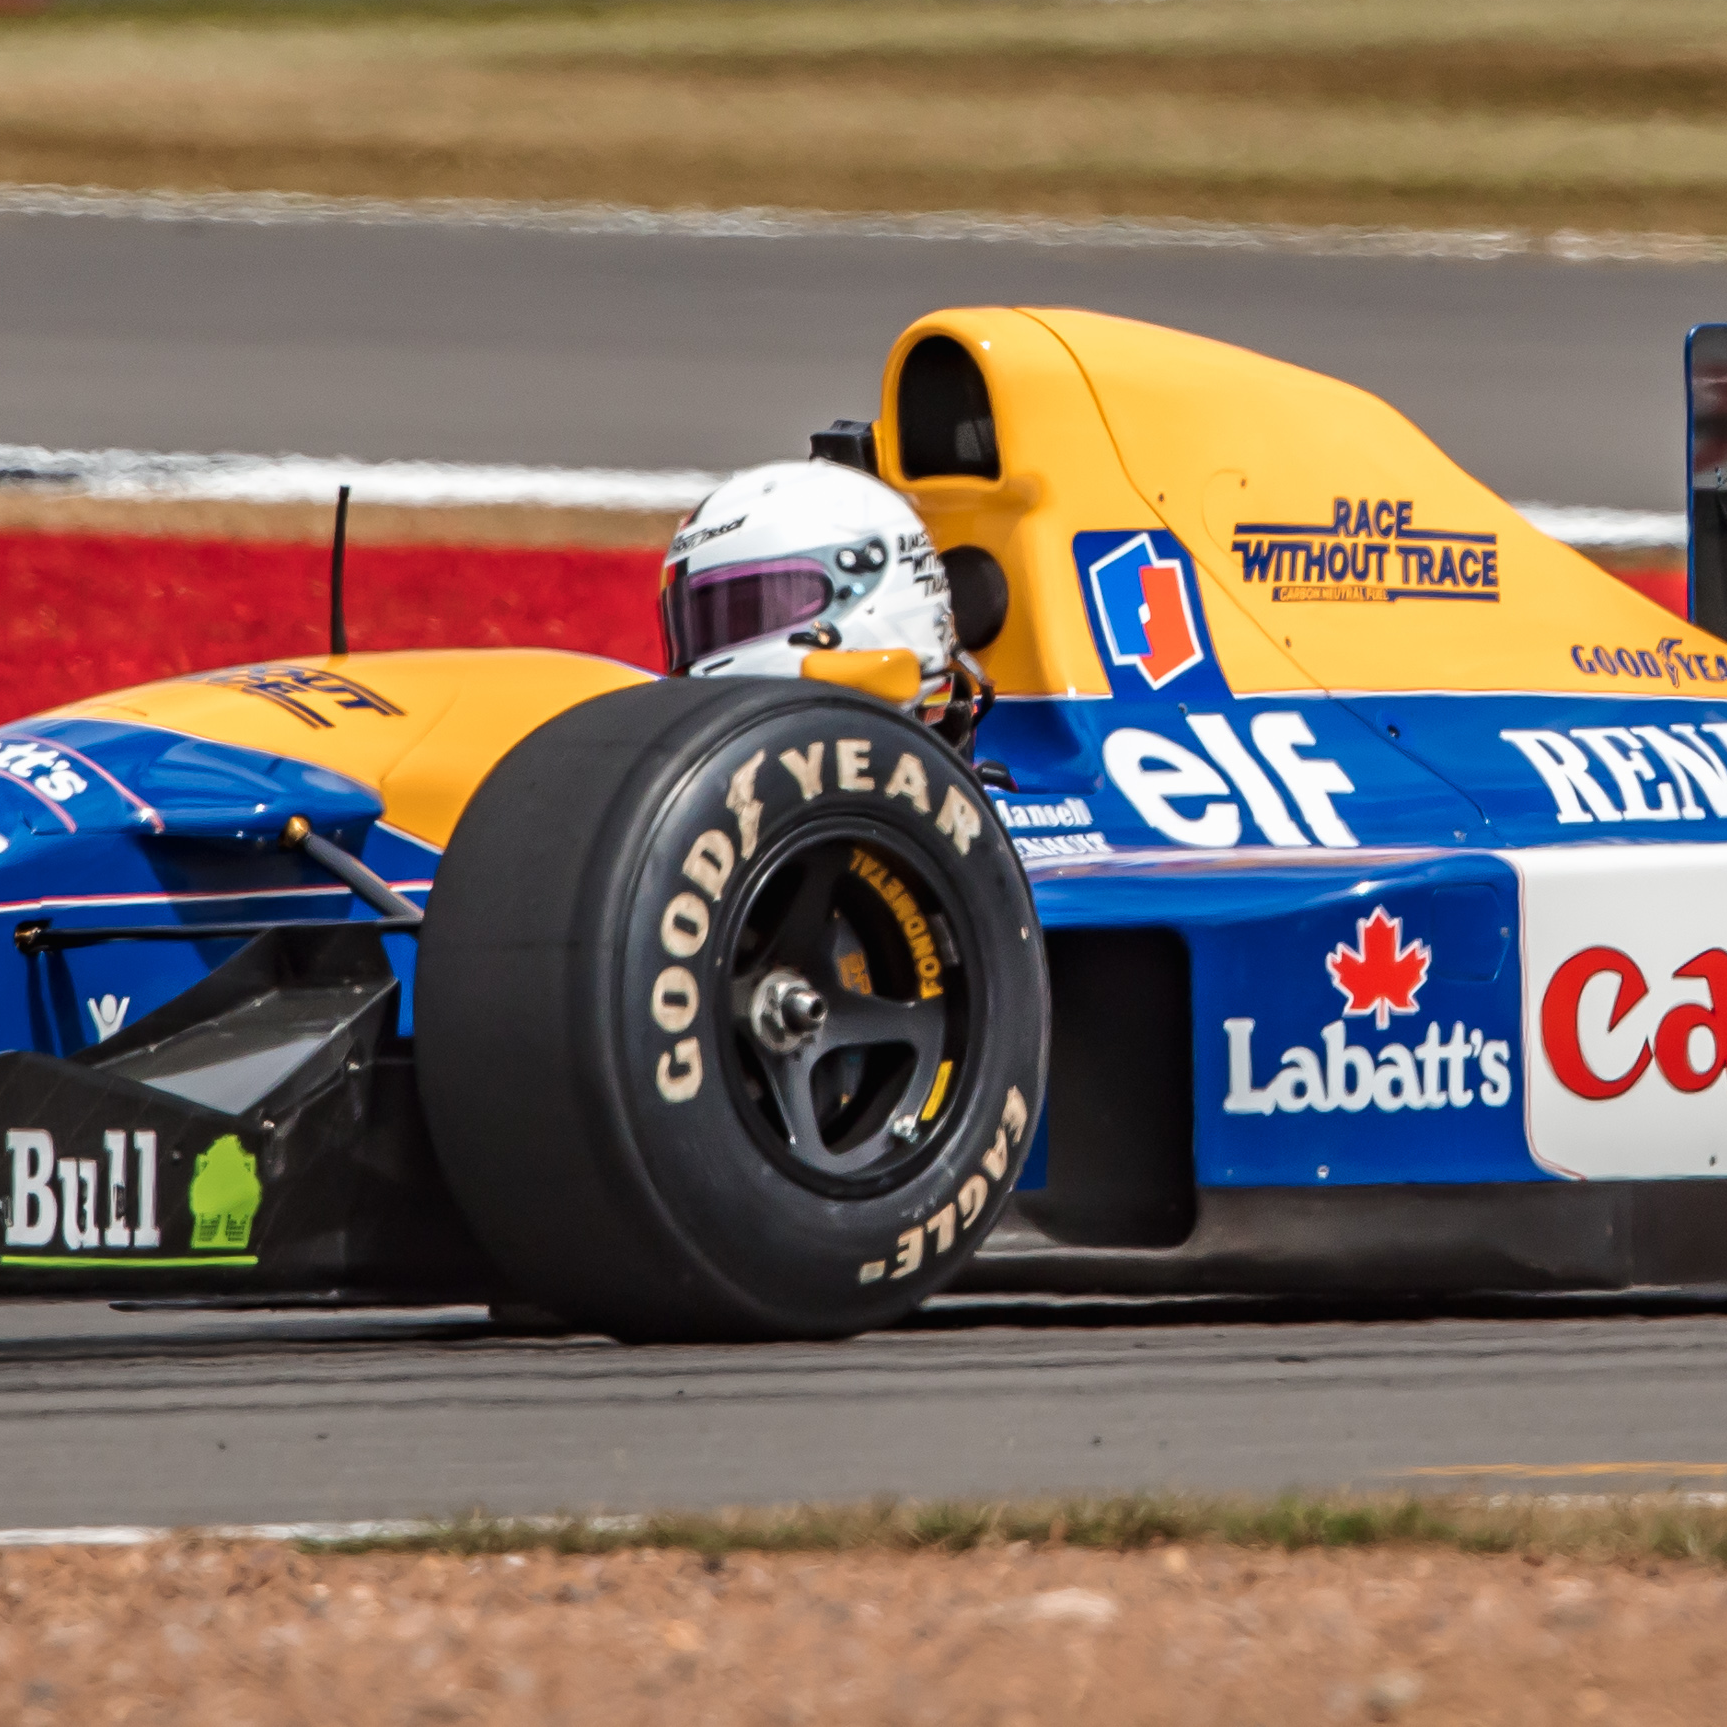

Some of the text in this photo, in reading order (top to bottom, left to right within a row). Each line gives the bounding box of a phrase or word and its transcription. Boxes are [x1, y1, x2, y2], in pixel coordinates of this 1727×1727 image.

[1334, 498, 1412, 538] RACE
[1232, 540, 1499, 587] WITHOUT TRACE
[995, 796, 1094, 828] ansell
[1103, 711, 1360, 848] elf
[1222, 1017, 1512, 1116] Labatt's
[5, 1129, 161, 1250] Bull
